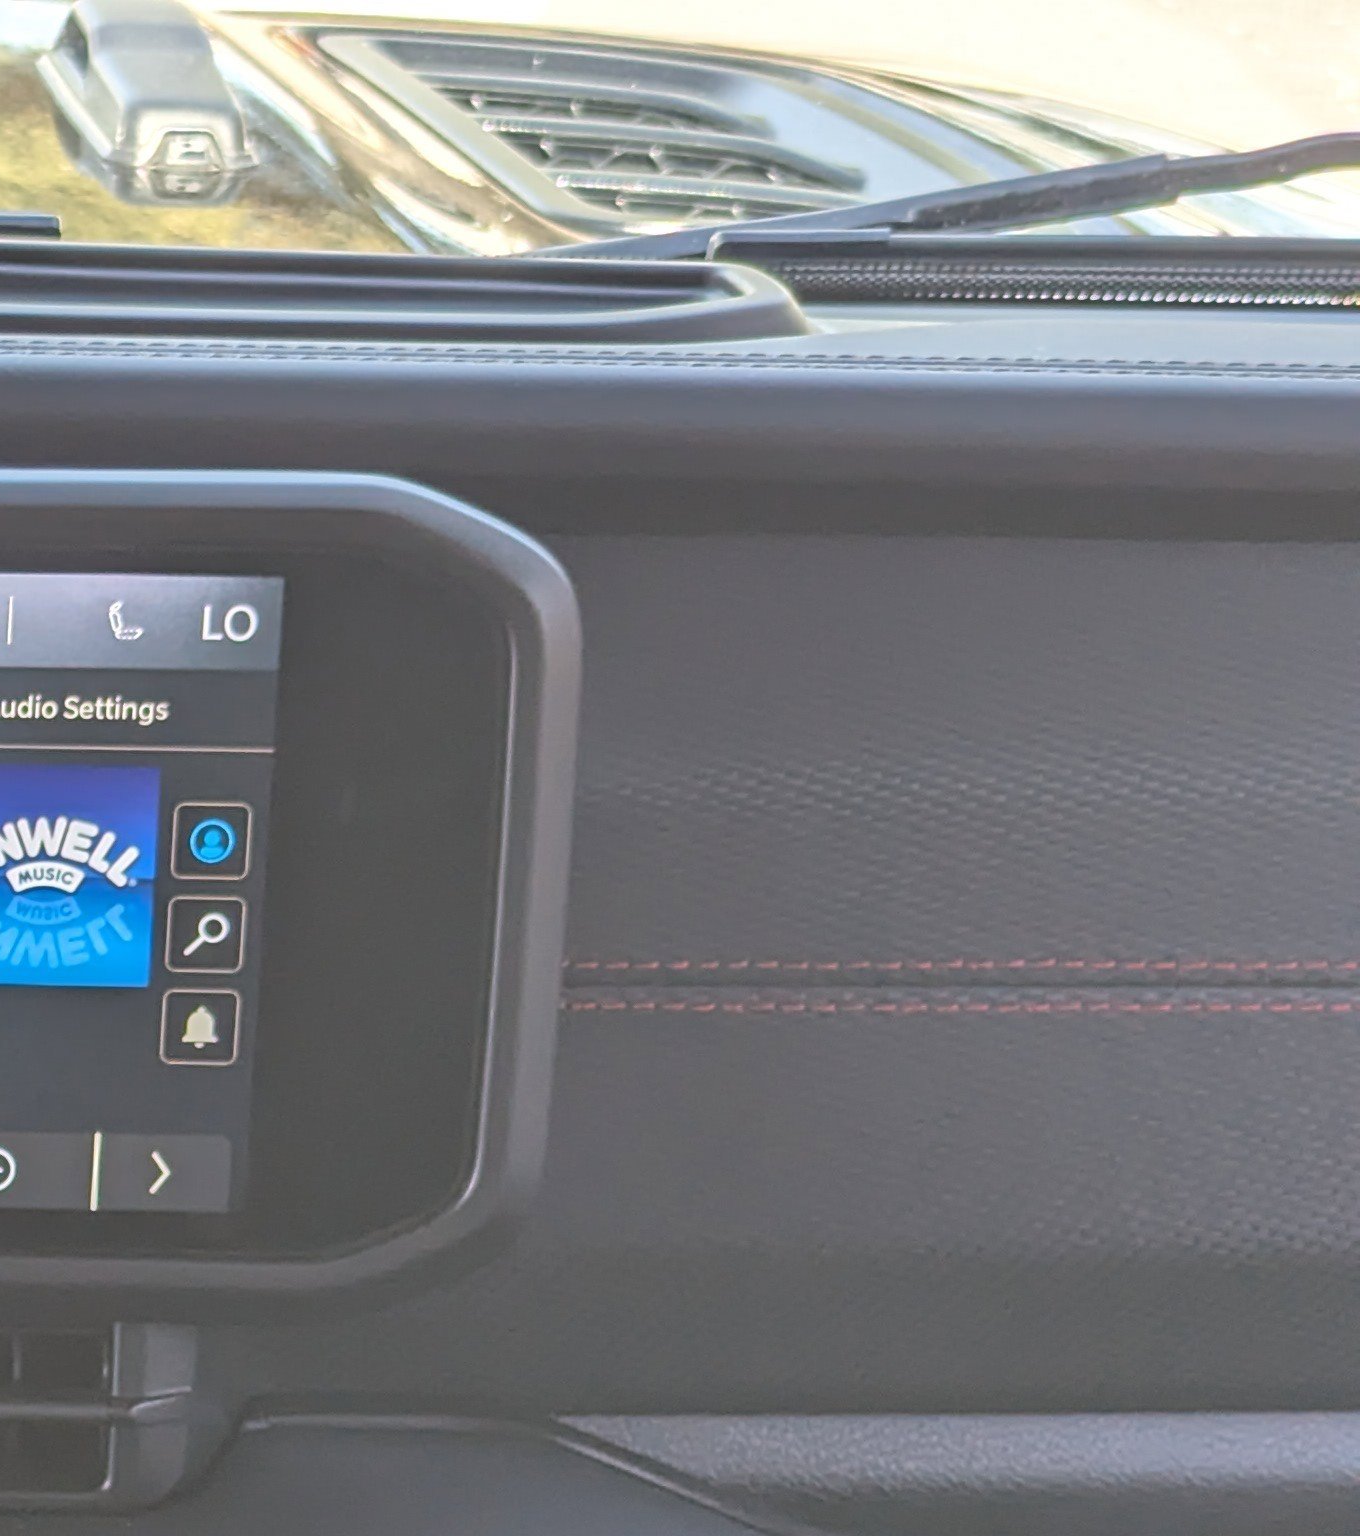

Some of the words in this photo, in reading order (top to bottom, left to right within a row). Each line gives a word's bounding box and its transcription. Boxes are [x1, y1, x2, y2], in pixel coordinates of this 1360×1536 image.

[201, 604, 259, 642] LO
[63, 695, 170, 727] Settings
[18, 866, 75, 885] MUSIC
